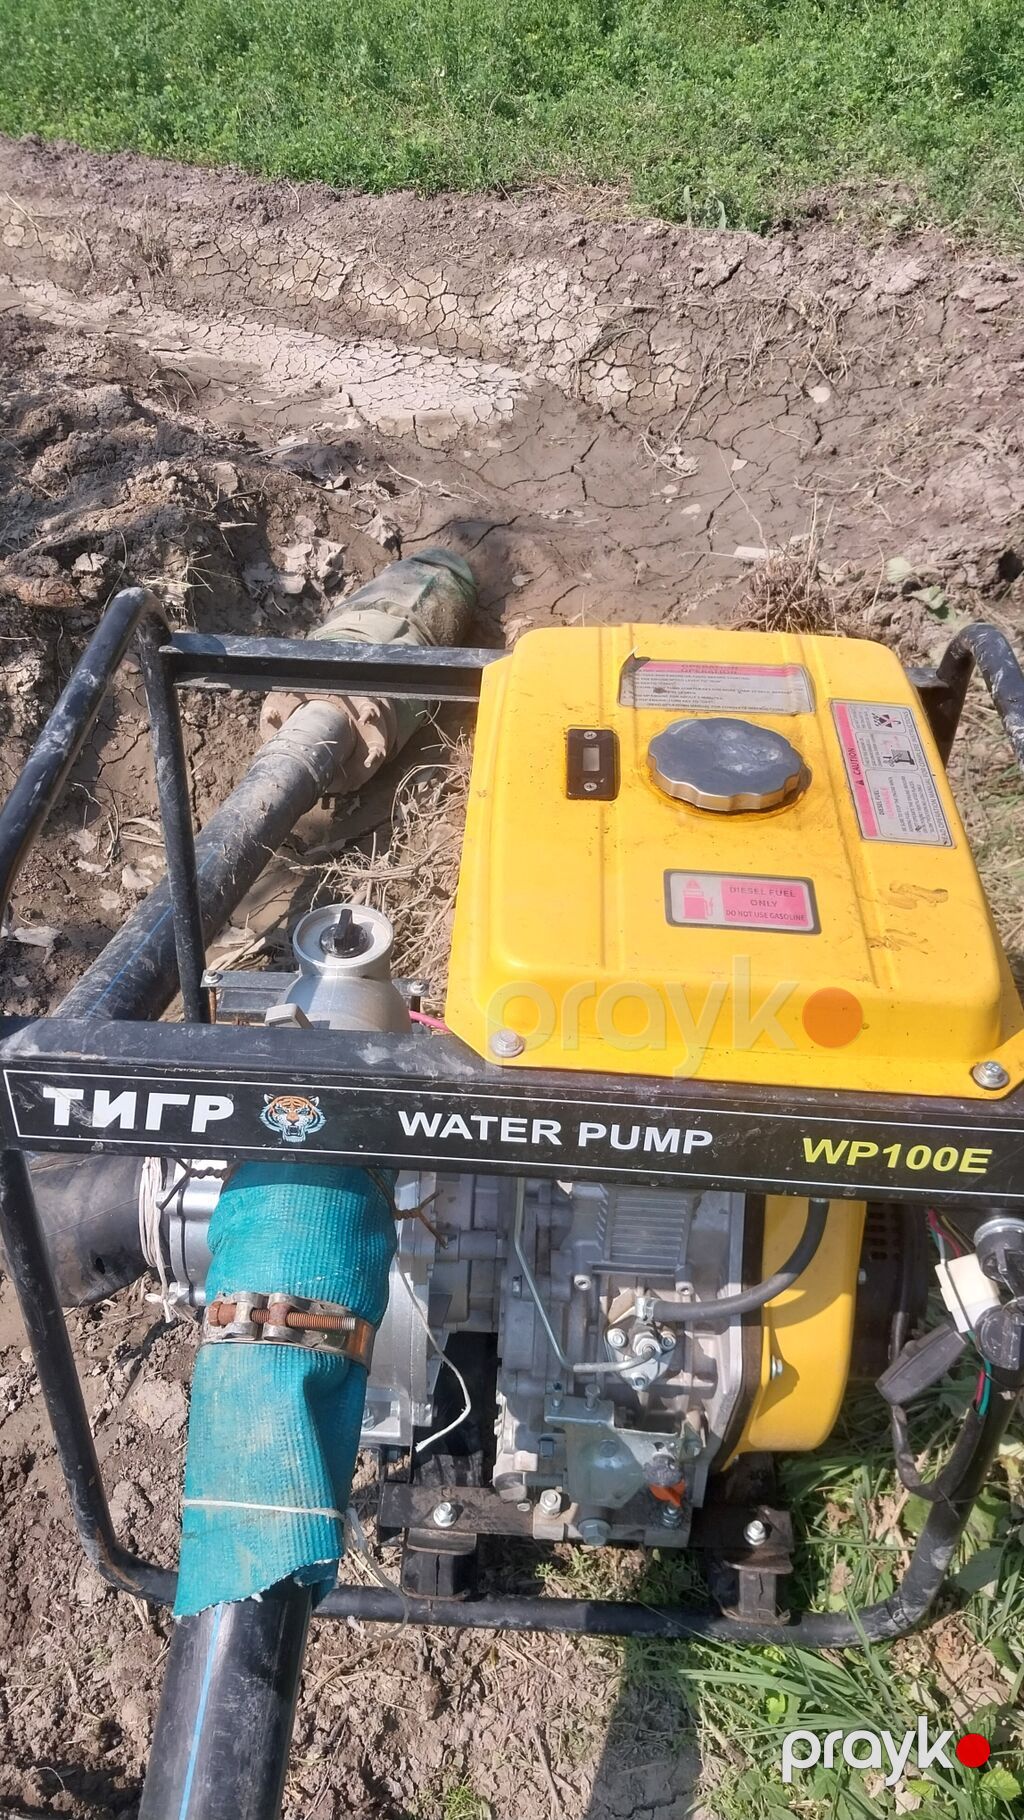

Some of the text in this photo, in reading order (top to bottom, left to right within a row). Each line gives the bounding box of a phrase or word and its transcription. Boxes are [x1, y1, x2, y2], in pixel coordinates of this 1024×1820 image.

[847, 747, 862, 776] CAUTION
[729, 886, 797, 898] DIESEL FUEL
[750, 899, 778, 908] ONLY
[769, 911, 806, 921] GASOLINE
[42, 1087, 234, 1133] ТИГР
[398, 1110, 713, 1155] WATER PUMP
[803, 1137, 993, 1174] WP100E
